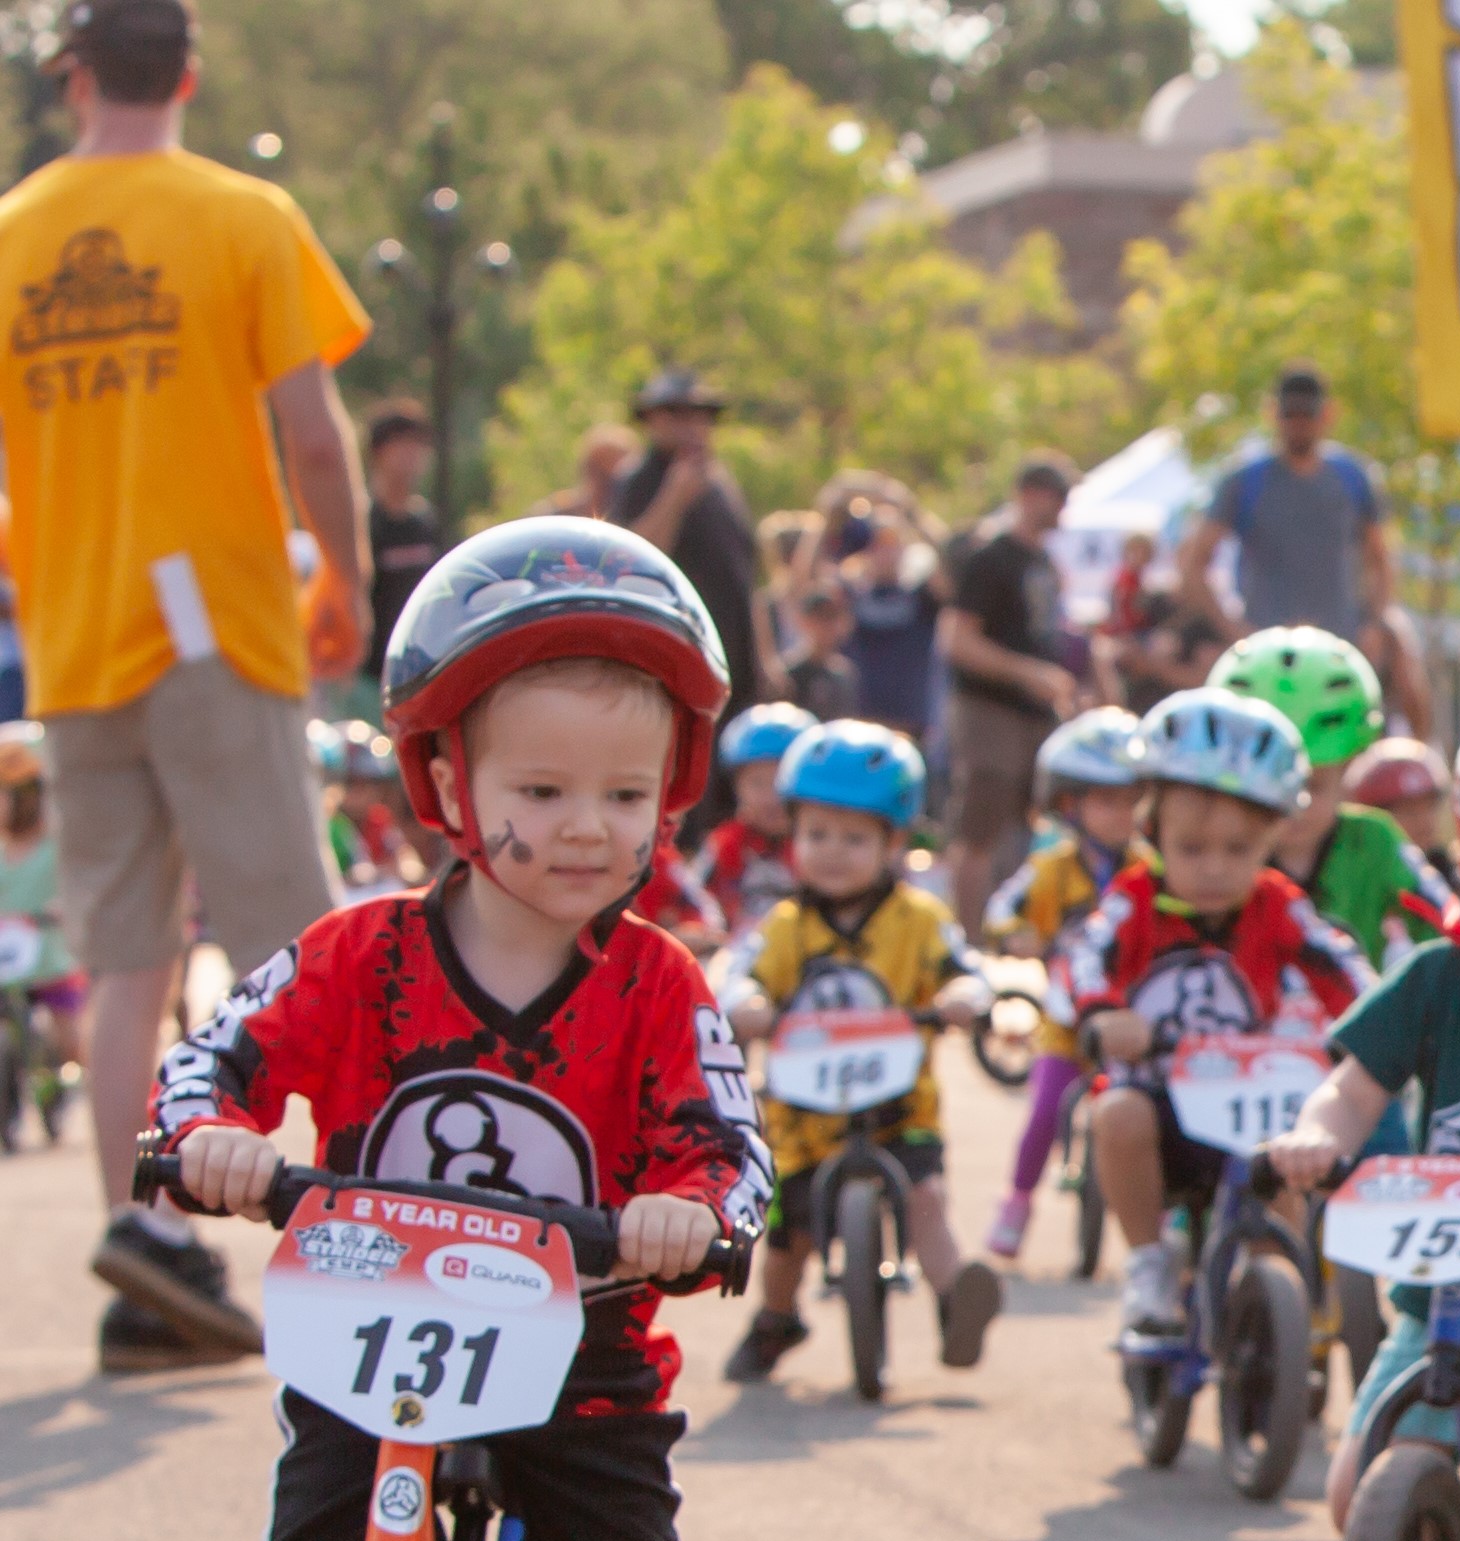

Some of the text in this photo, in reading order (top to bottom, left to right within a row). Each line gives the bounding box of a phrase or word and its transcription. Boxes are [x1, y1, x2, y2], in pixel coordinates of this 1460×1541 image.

[353, 1196, 521, 1244] 2 YEAR OLD
[351, 1315, 501, 1406] 131
